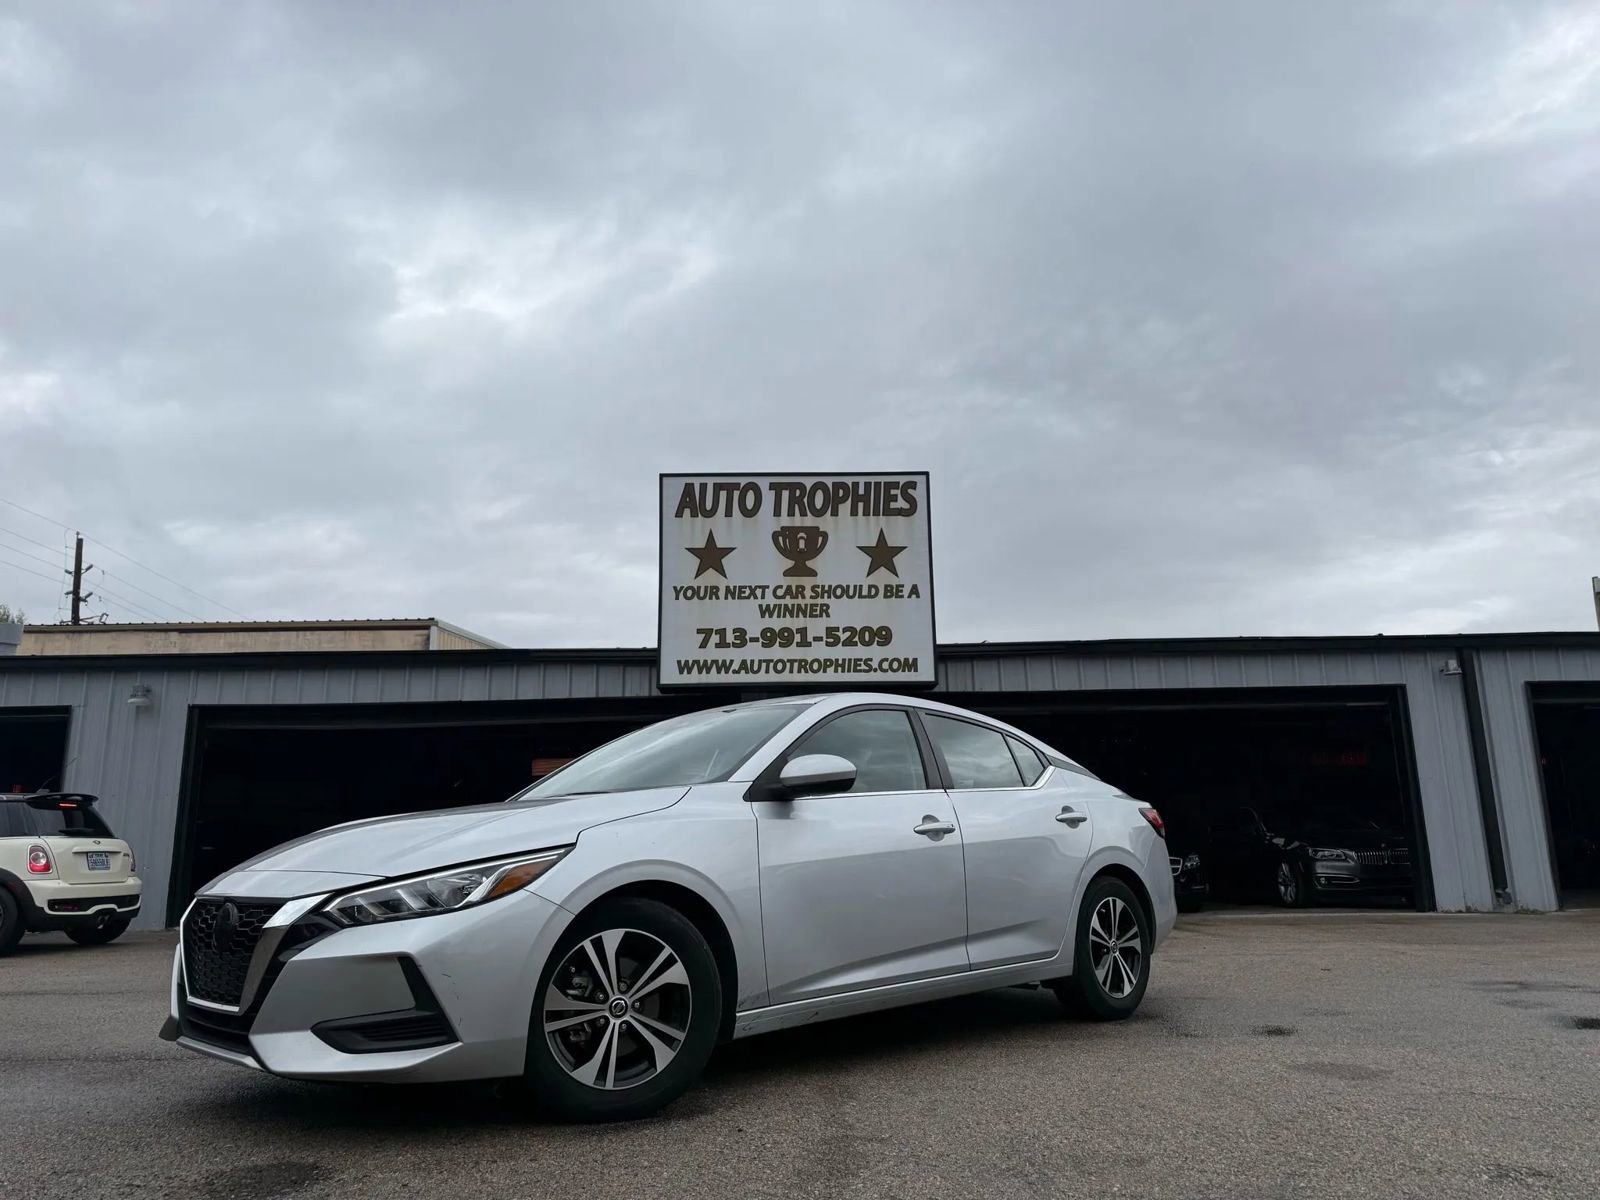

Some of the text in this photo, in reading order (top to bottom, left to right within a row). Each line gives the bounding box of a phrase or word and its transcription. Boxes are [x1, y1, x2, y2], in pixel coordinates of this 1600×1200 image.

[675, 481, 917, 518] AUTO TROPHIES
[673, 584, 920, 600] YOUR NEXT CAR SHOULD BE A
[758, 603, 830, 618] WINNER
[696, 626, 892, 649] 713-991-5209
[677, 658, 918, 675] WWW.AUTOTROPHIES.COM
